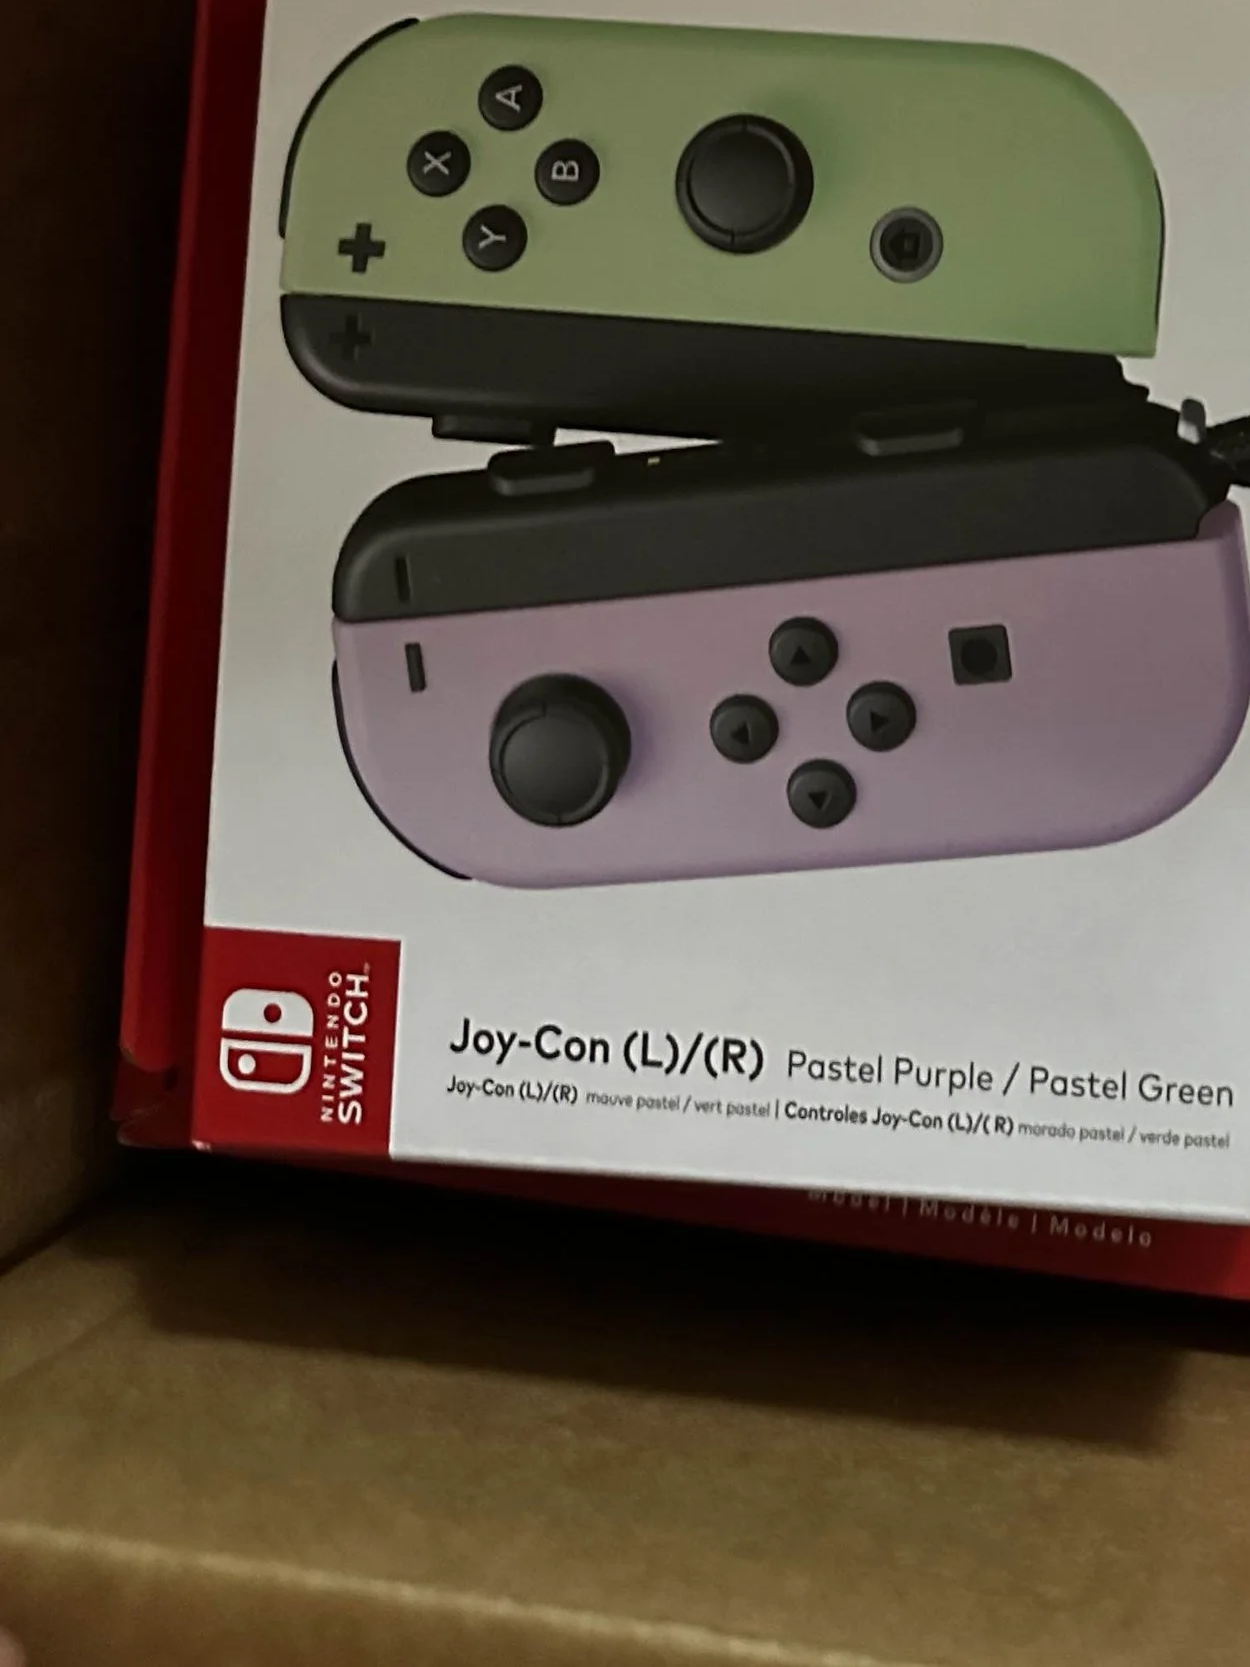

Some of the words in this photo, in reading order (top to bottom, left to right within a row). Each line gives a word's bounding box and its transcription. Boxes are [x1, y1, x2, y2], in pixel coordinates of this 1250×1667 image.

[495, 85, 523, 113] A
[423, 150, 452, 176] X
[552, 160, 579, 183] B
[479, 225, 507, 249] Y
[320, 971, 342, 1122] NINTENDO
[338, 973, 370, 1125] SWITCH
[450, 1017, 609, 1064] Joy-Con
[623, 1031, 764, 1080] (L)/(R)
[788, 1049, 882, 1083] Pastel
[895, 1056, 993, 1096] Purple
[1030, 1066, 1127, 1100] Pastel
[1138, 1073, 1234, 1107] Green
[447, 1076, 514, 1098] Joy-Con
[519, 1081, 578, 1104] (L)/(R)
[586, 1090, 633, 1108] mauve
[636, 1095, 681, 1112] pastel
[694, 1098, 722, 1115] vert
[726, 1100, 770, 1117] pastel
[785, 1101, 867, 1125] Controles
[872, 1107, 943, 1130] Joy-Con
[1018, 1121, 1075, 1138] morado
[1079, 1124, 1125, 1142] pastel
[1139, 1129, 1180, 1146] verde
[1183, 1133, 1230, 1150] pastel
[1049, 1214, 1152, 1248] Modelo
